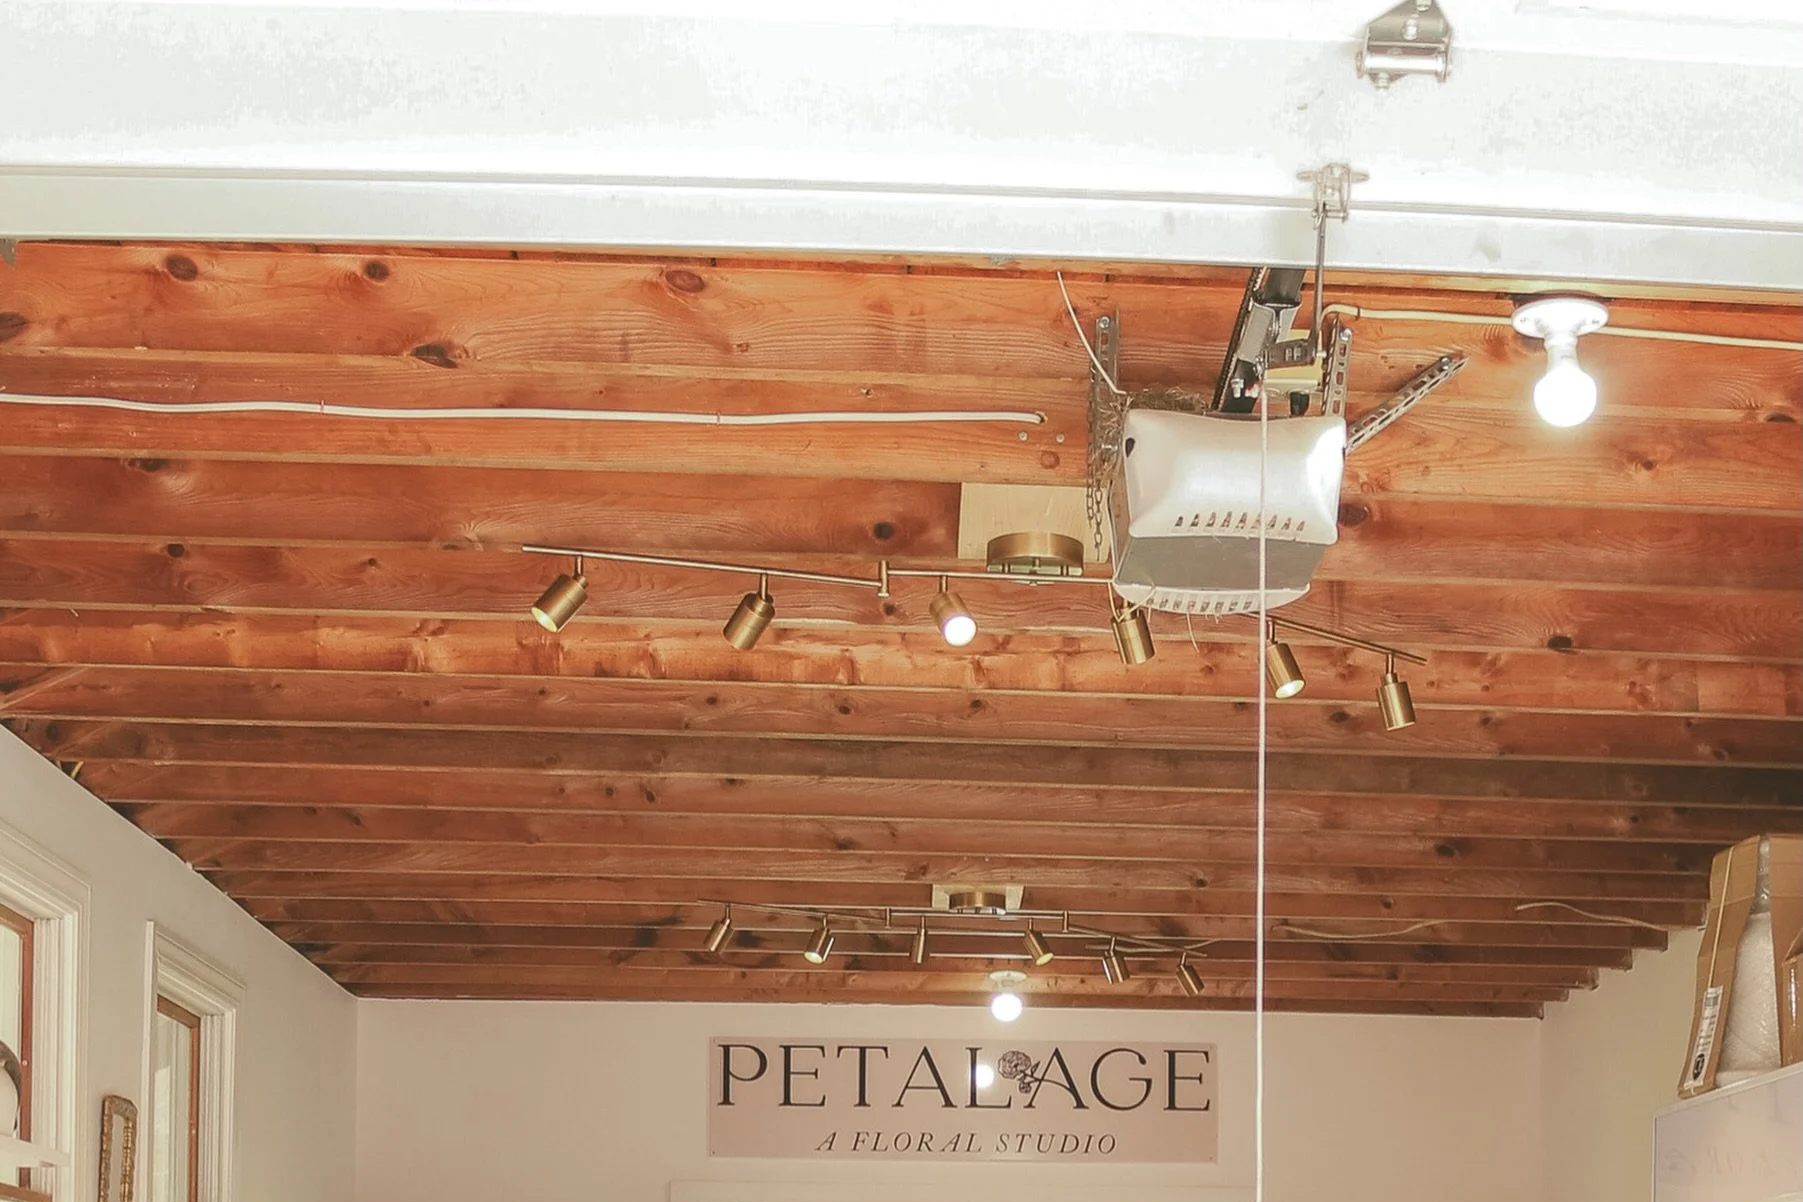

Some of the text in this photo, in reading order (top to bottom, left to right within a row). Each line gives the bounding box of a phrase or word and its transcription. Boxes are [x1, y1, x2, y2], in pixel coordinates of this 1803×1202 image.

[716, 1043, 1211, 1111] PETALAGE
[815, 1131, 1117, 1153] A FLORAL STUDIO
